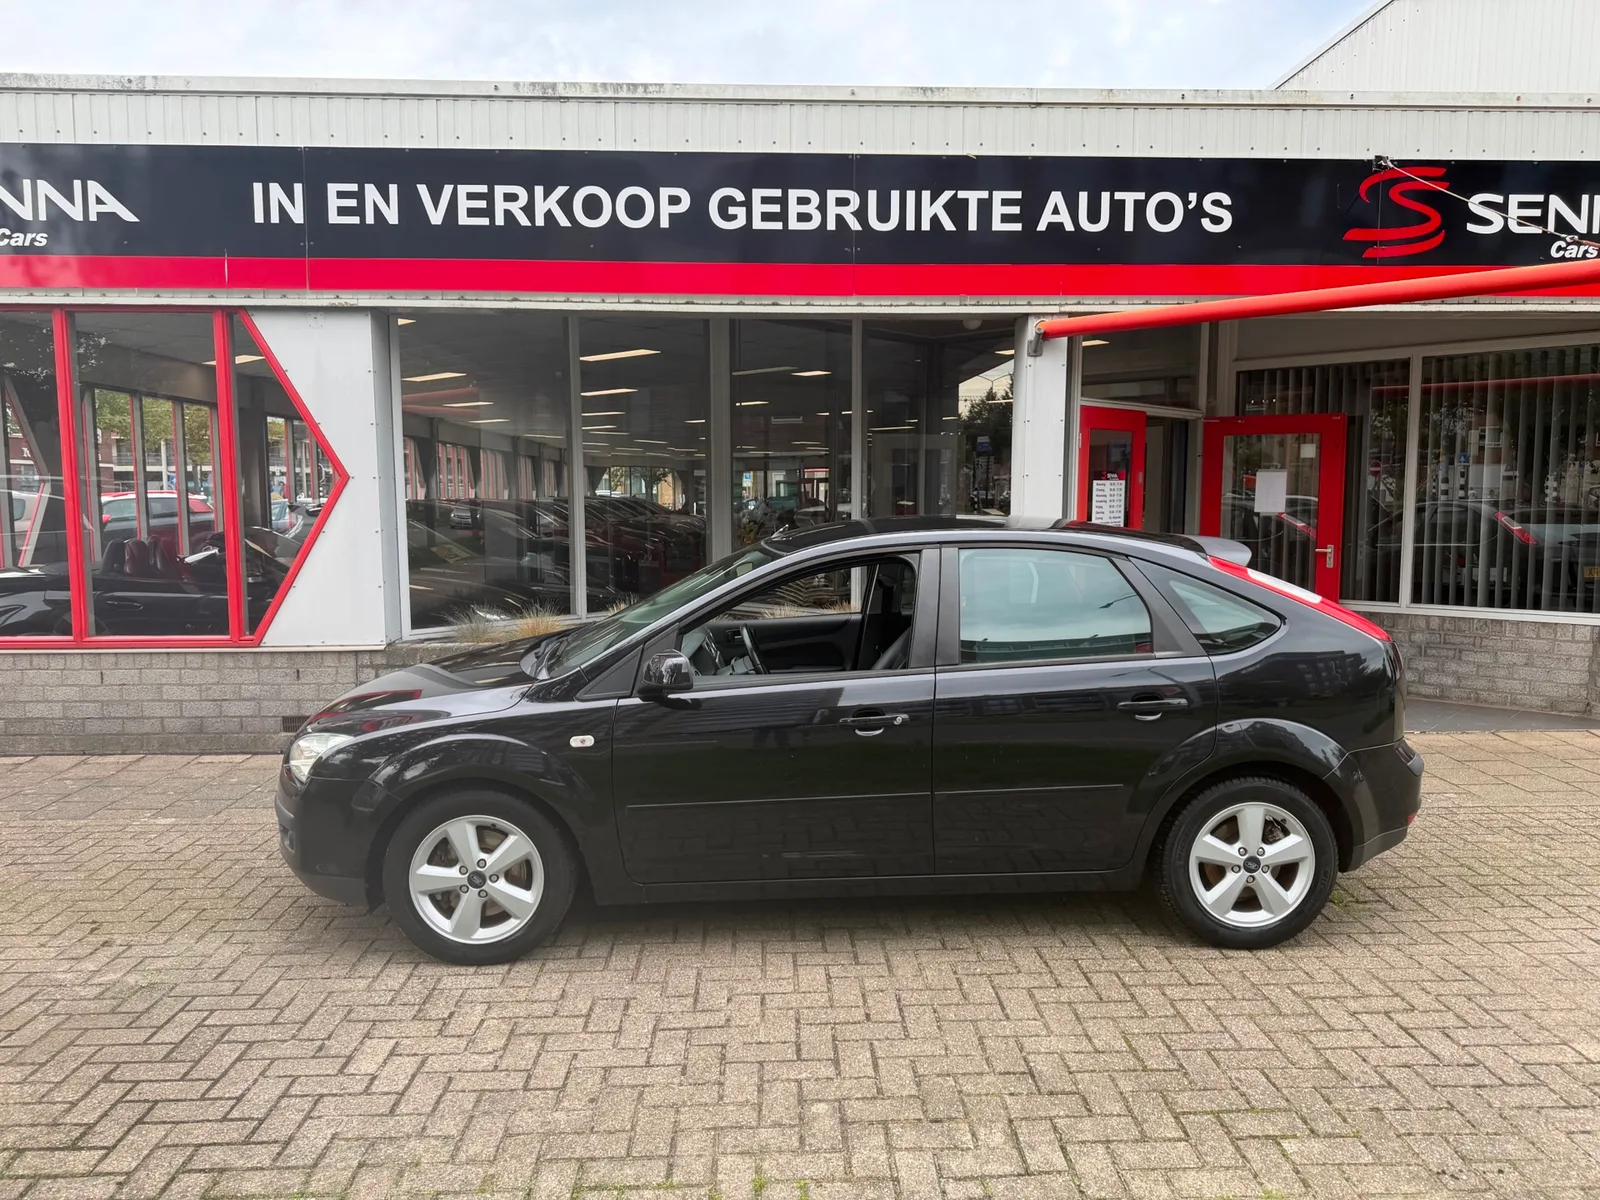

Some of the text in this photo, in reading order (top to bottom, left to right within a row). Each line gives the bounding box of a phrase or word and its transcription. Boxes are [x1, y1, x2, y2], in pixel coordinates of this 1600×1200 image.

[252, 182, 1233, 233] IN EN VERKOOP GEBRUIKTE AUTO’S
[1466, 193, 1600, 235] SEN
[0, 227, 49, 247] Cars
[1550, 240, 1600, 259] Cars
